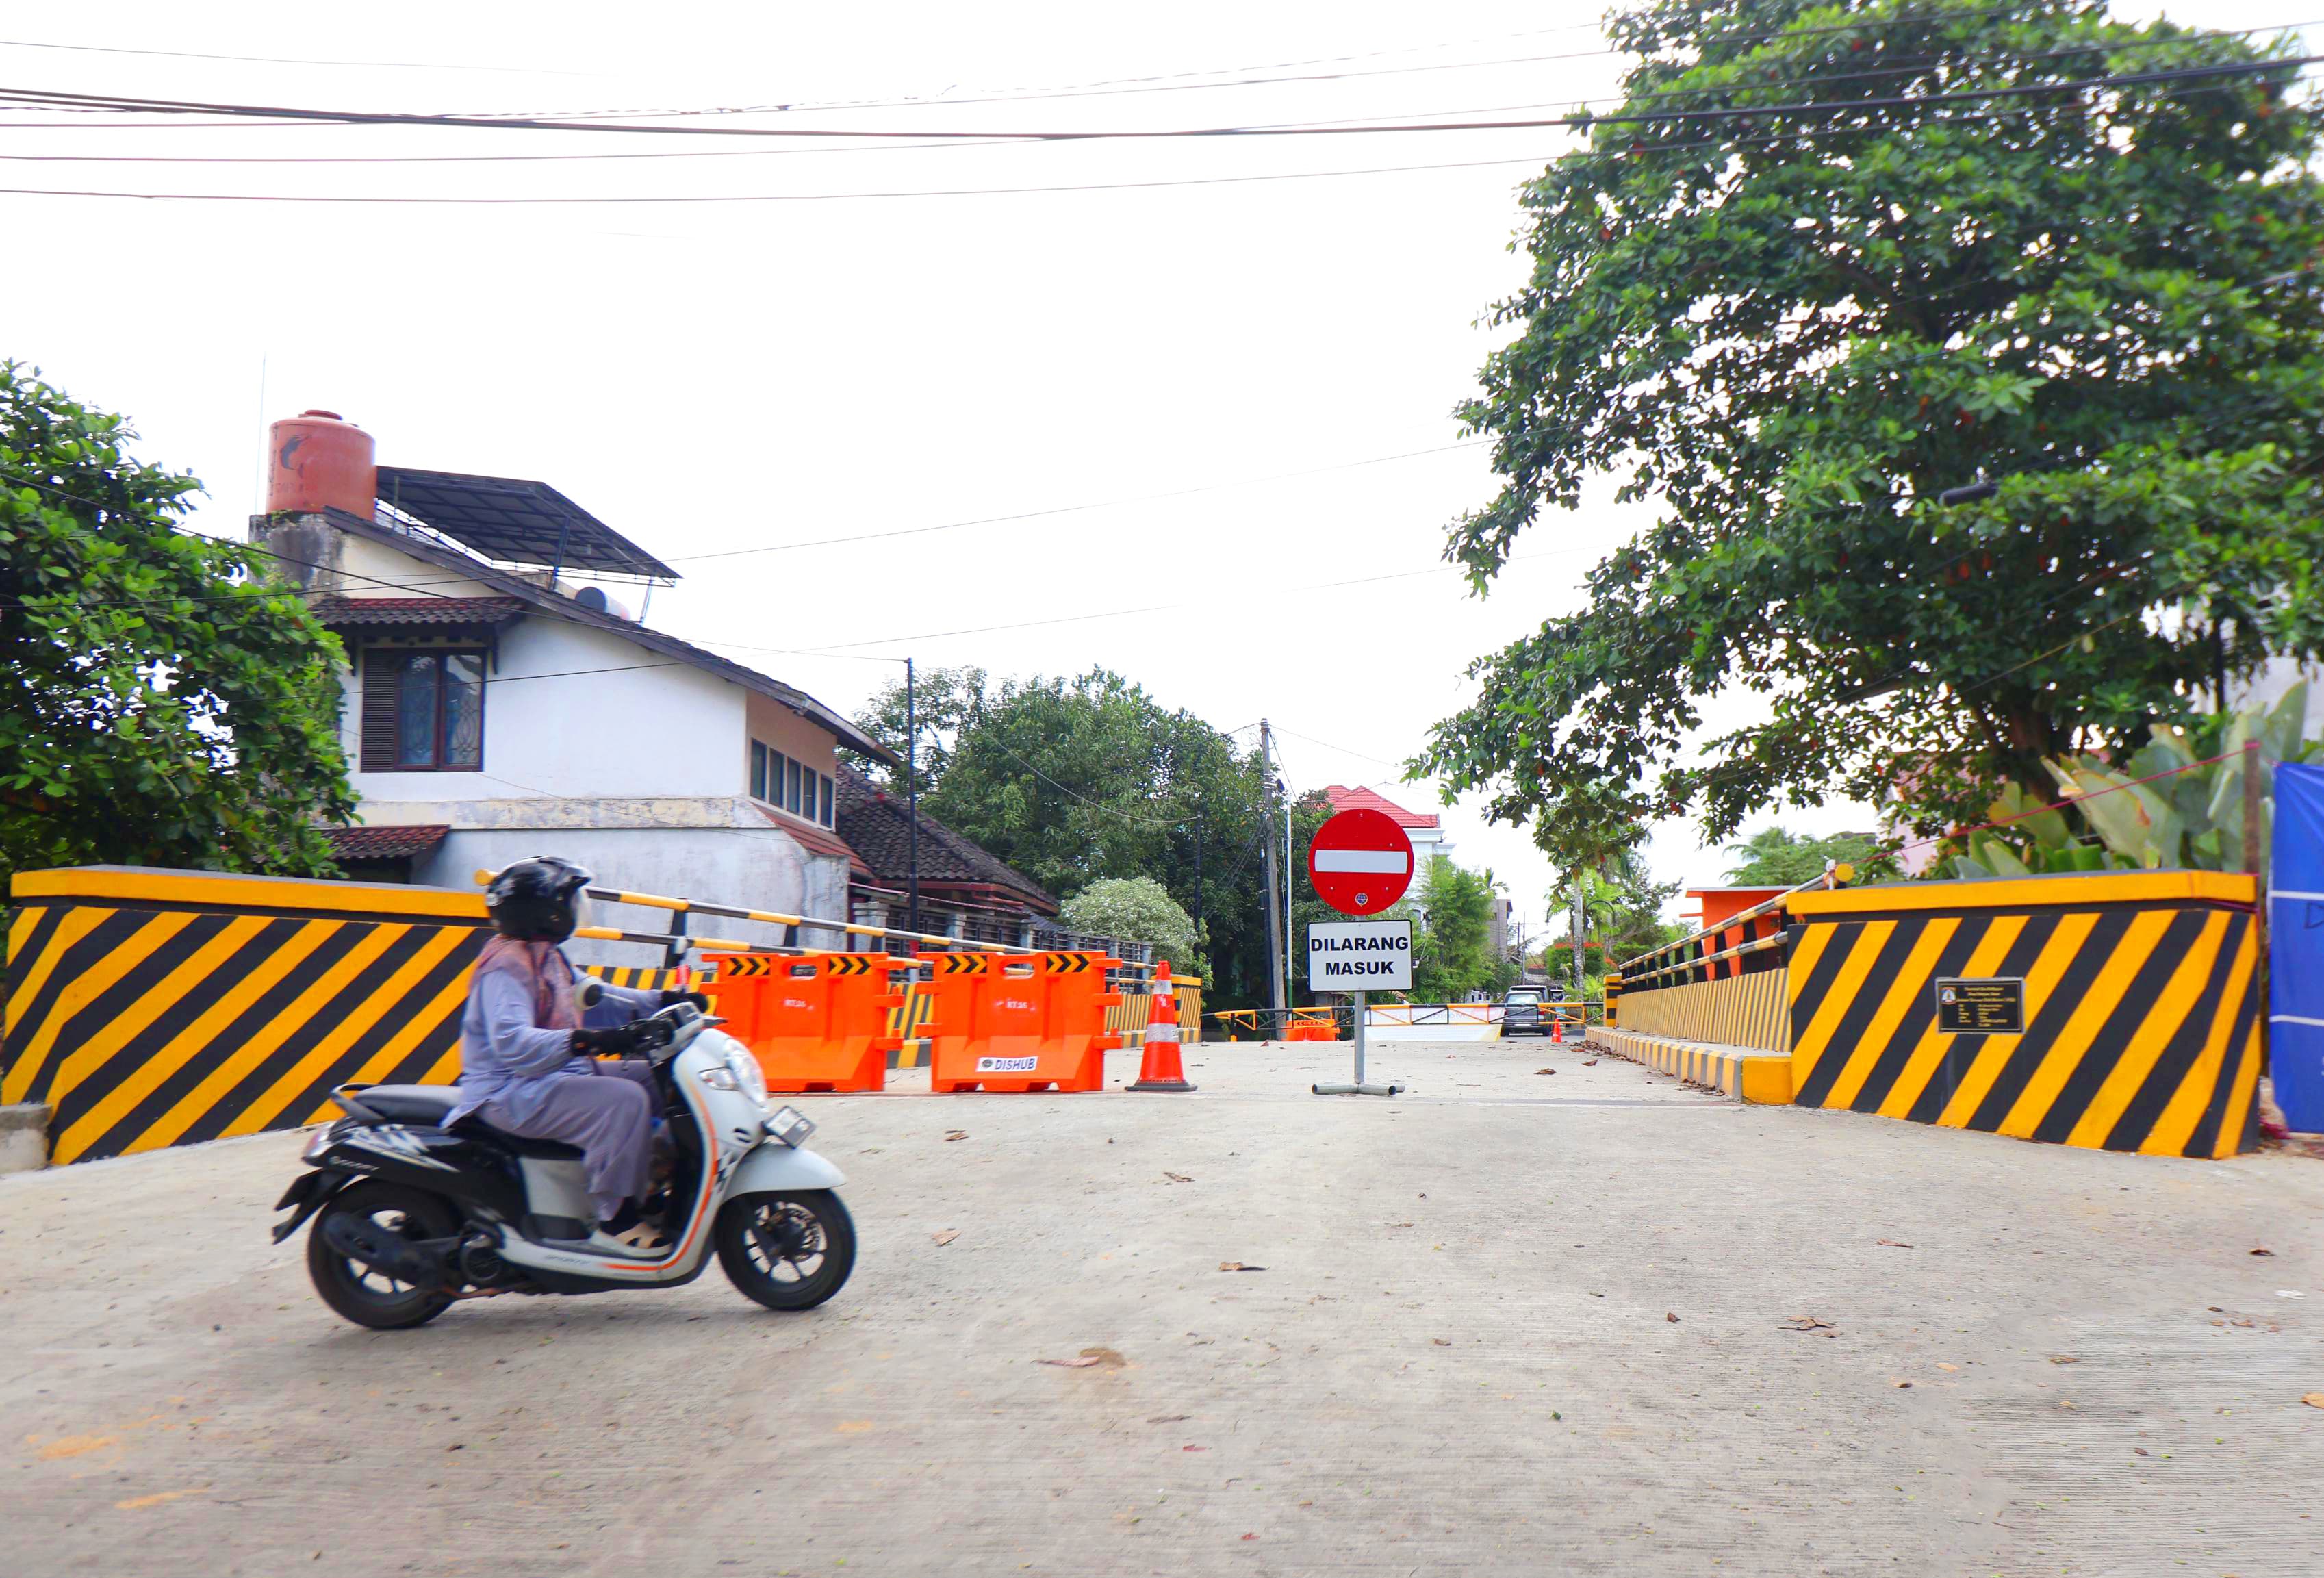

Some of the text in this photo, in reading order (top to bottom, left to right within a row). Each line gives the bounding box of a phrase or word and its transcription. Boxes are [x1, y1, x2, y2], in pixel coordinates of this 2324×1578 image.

[1311, 937, 1408, 952] DILARANG
[1325, 961, 1394, 976] MASUK
[995, 1058, 1035, 1070] DISHUB
